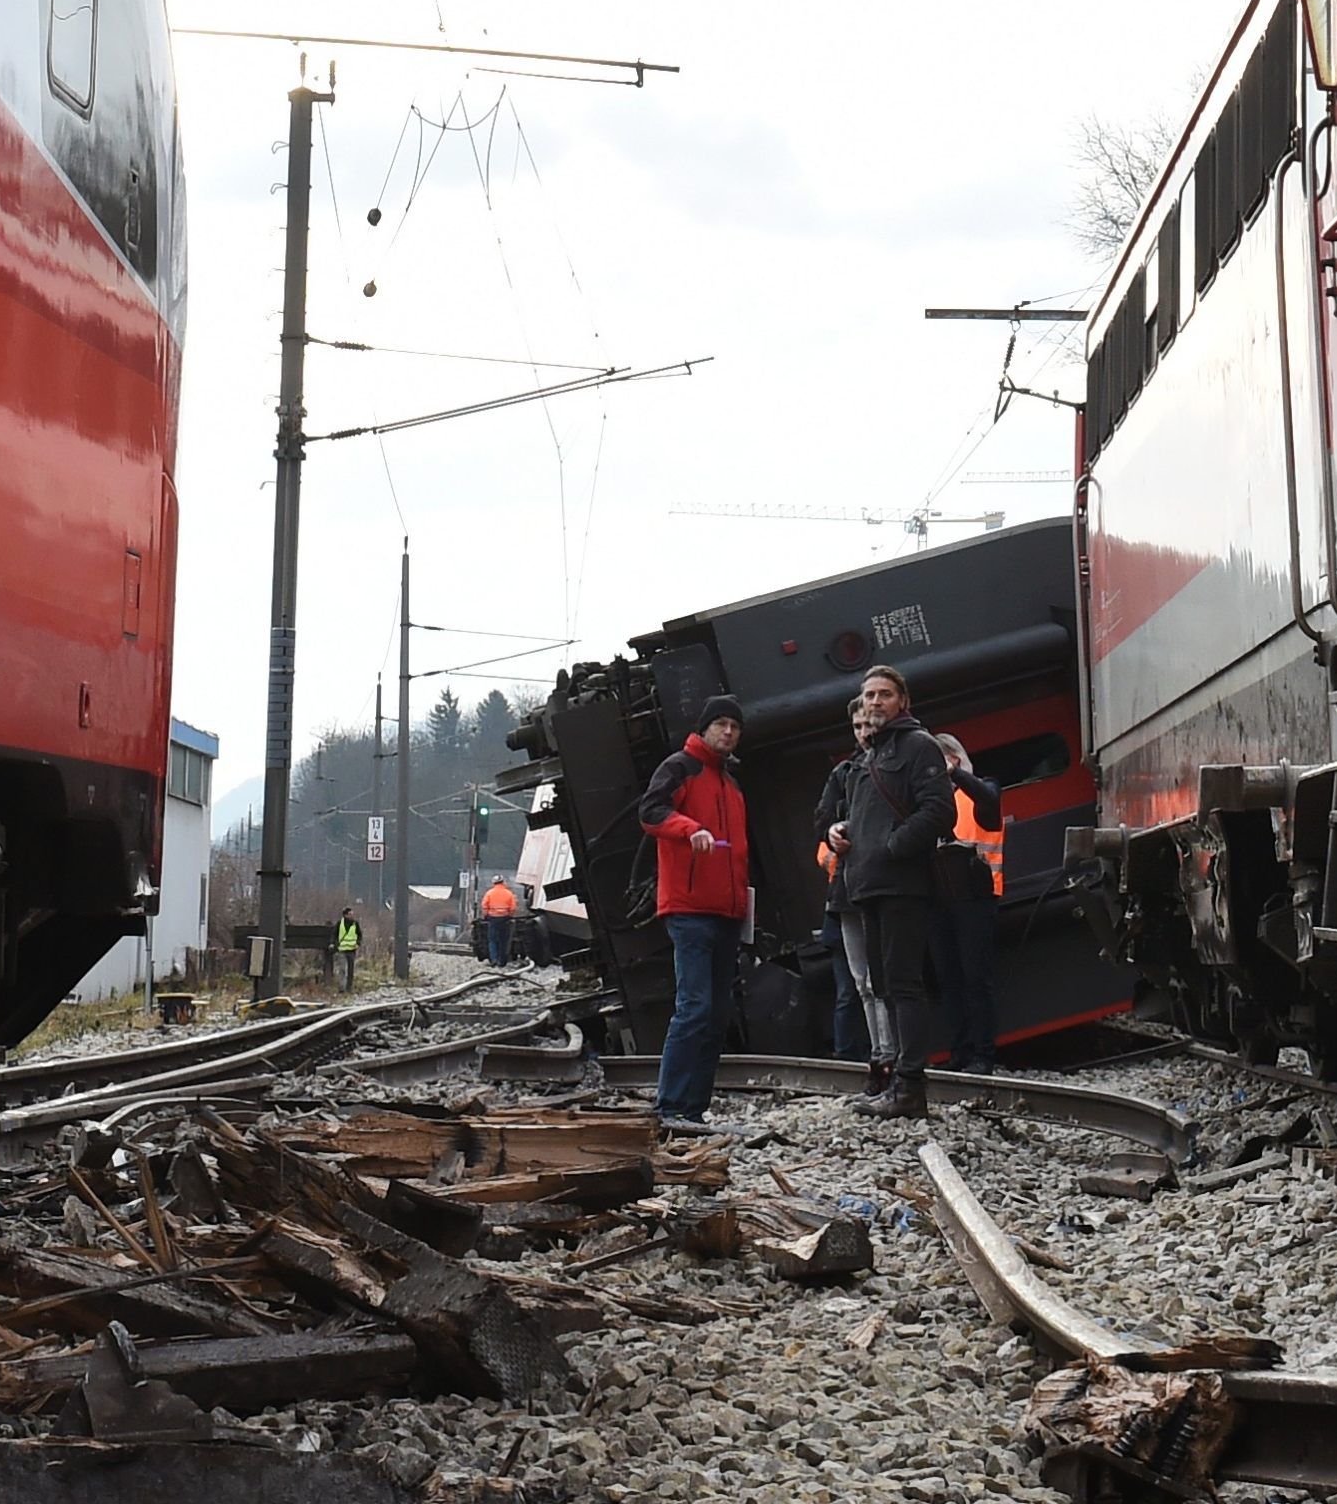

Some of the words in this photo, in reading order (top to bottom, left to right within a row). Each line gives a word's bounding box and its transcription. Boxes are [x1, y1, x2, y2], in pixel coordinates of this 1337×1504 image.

[371, 819, 381, 830] 13
[373, 831, 379, 840] 4
[371, 846, 382, 858] 12
